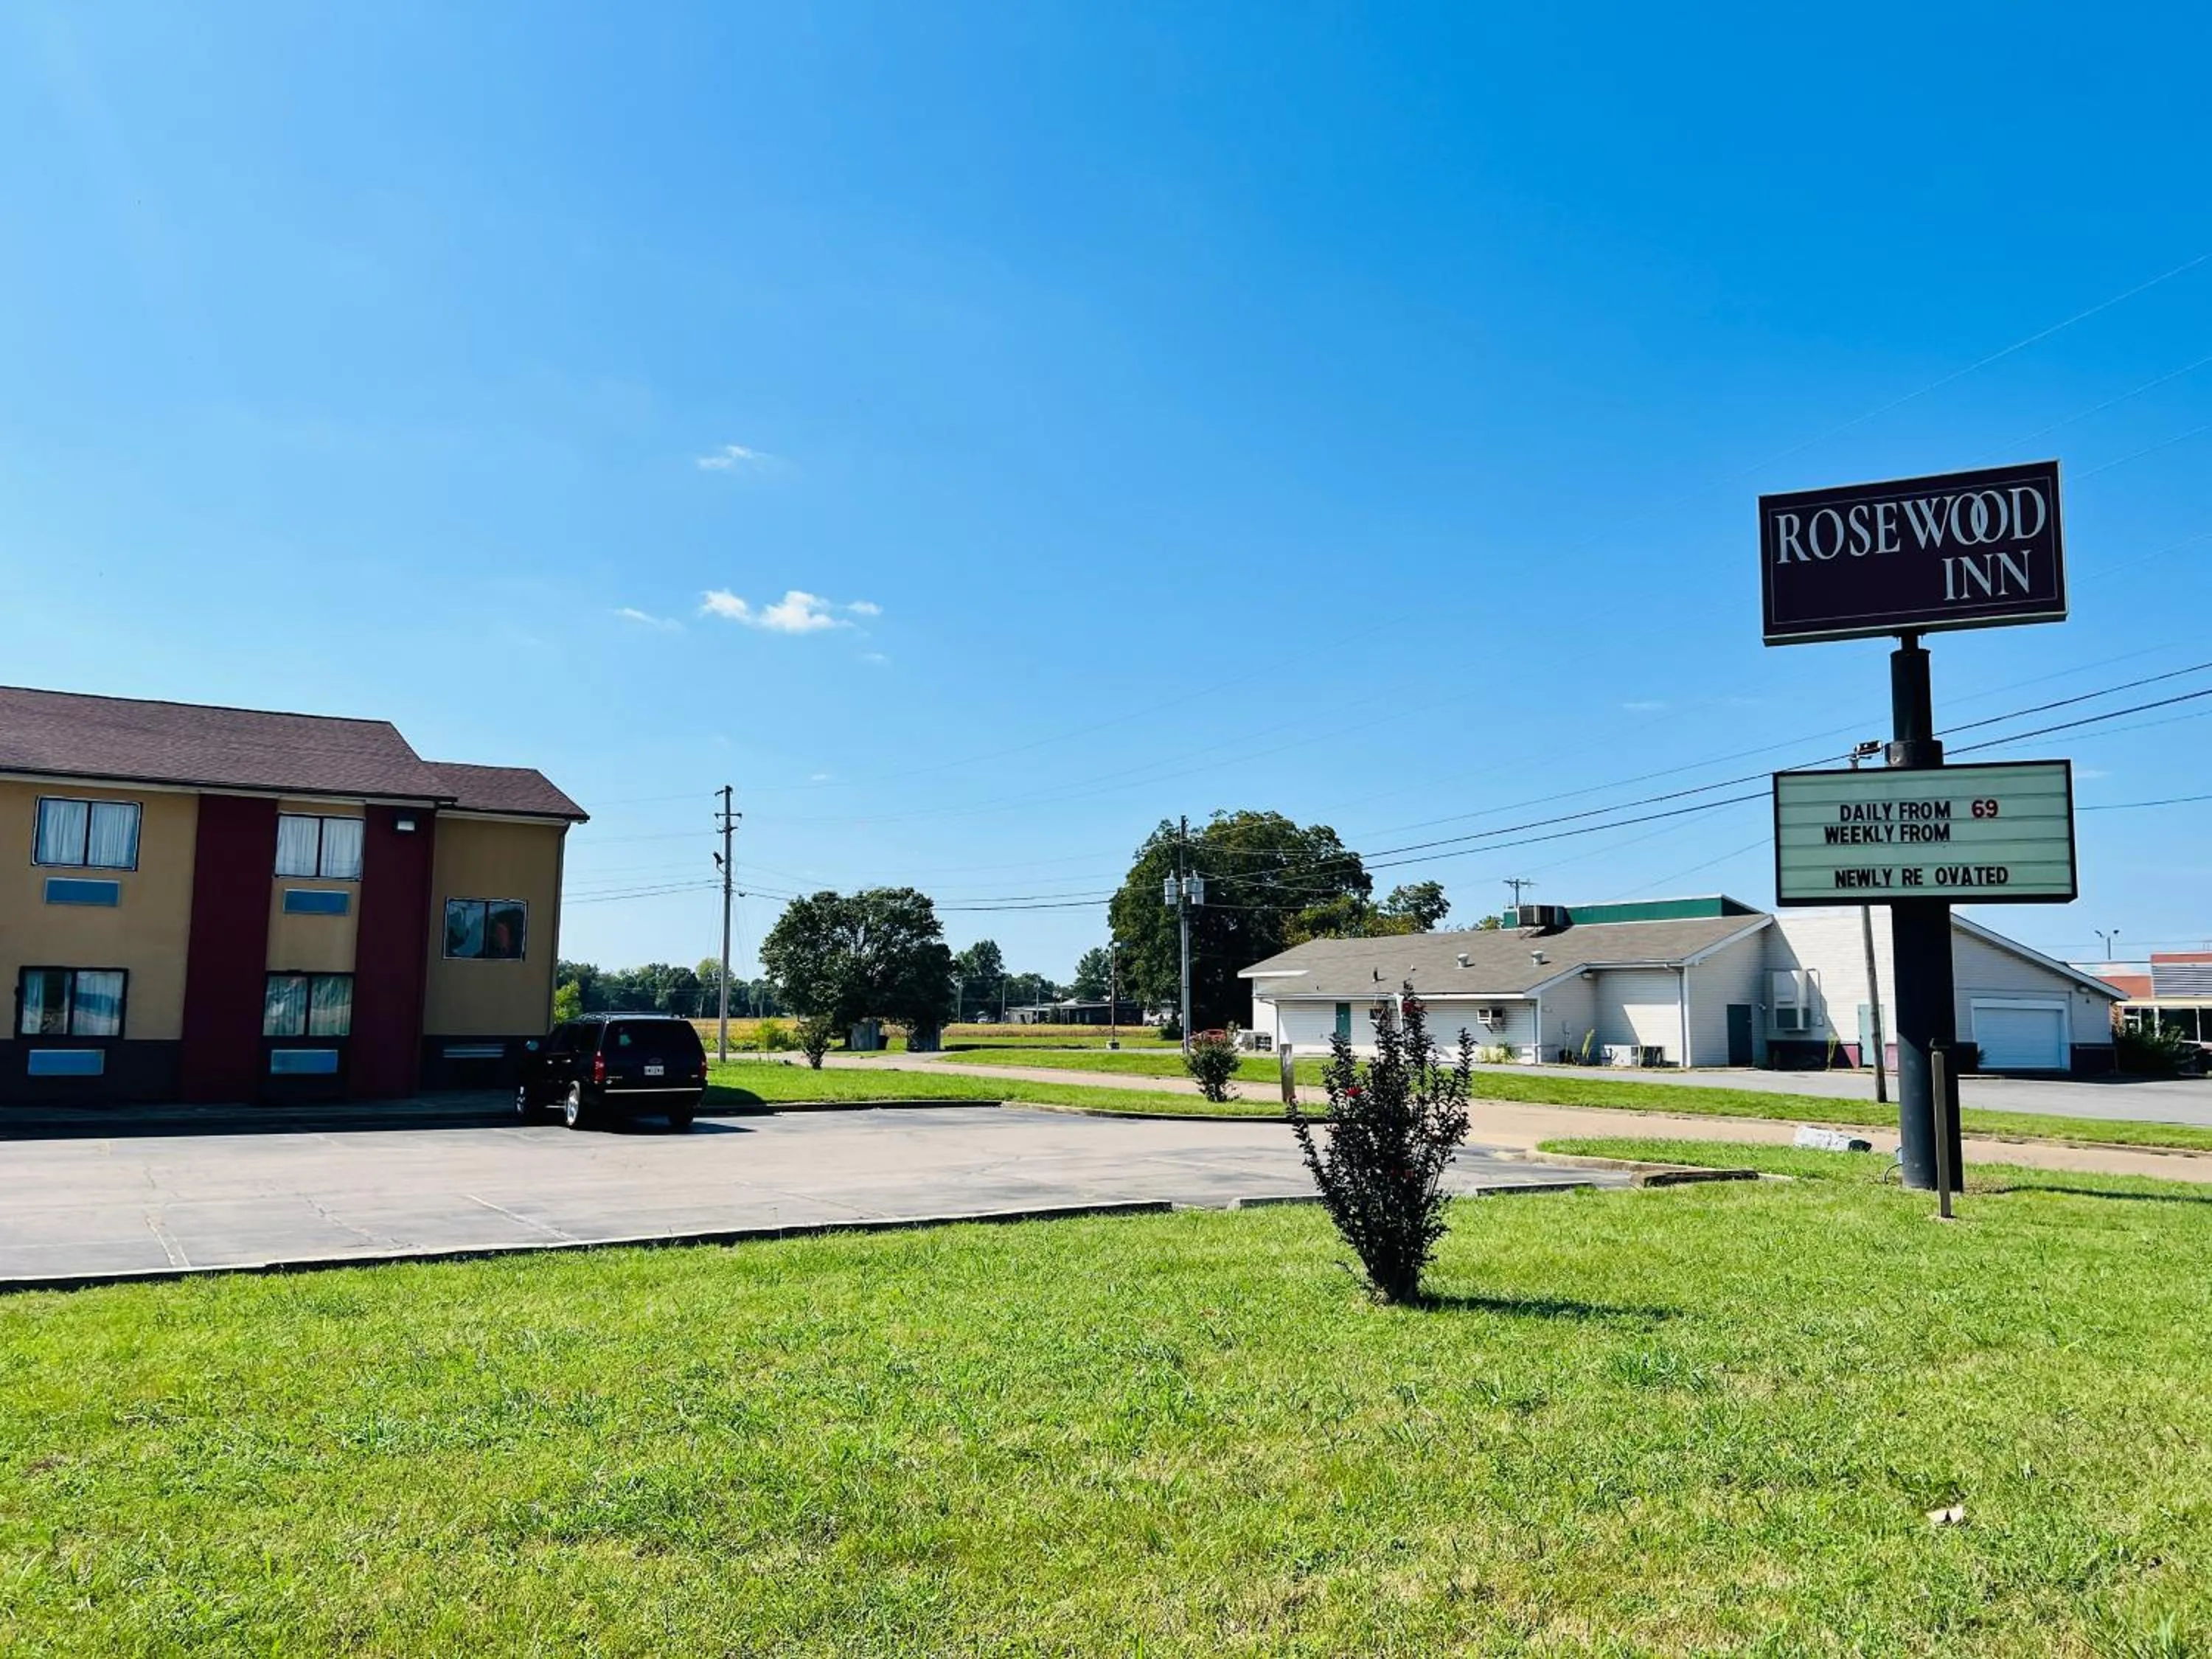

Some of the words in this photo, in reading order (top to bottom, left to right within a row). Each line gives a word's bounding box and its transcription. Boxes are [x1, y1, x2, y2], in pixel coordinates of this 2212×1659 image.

[1775, 486, 2046, 564] ROSEWOOD
[1941, 549, 2031, 601] INN
[1840, 802, 1893, 822] DAILY
[1899, 801, 1951, 821] FROM
[1971, 799, 1999, 818] 69
[1824, 824, 1893, 844] WEEKLY
[1899, 823, 1950, 842] FROM
[1834, 869, 1893, 888] NEWLY
